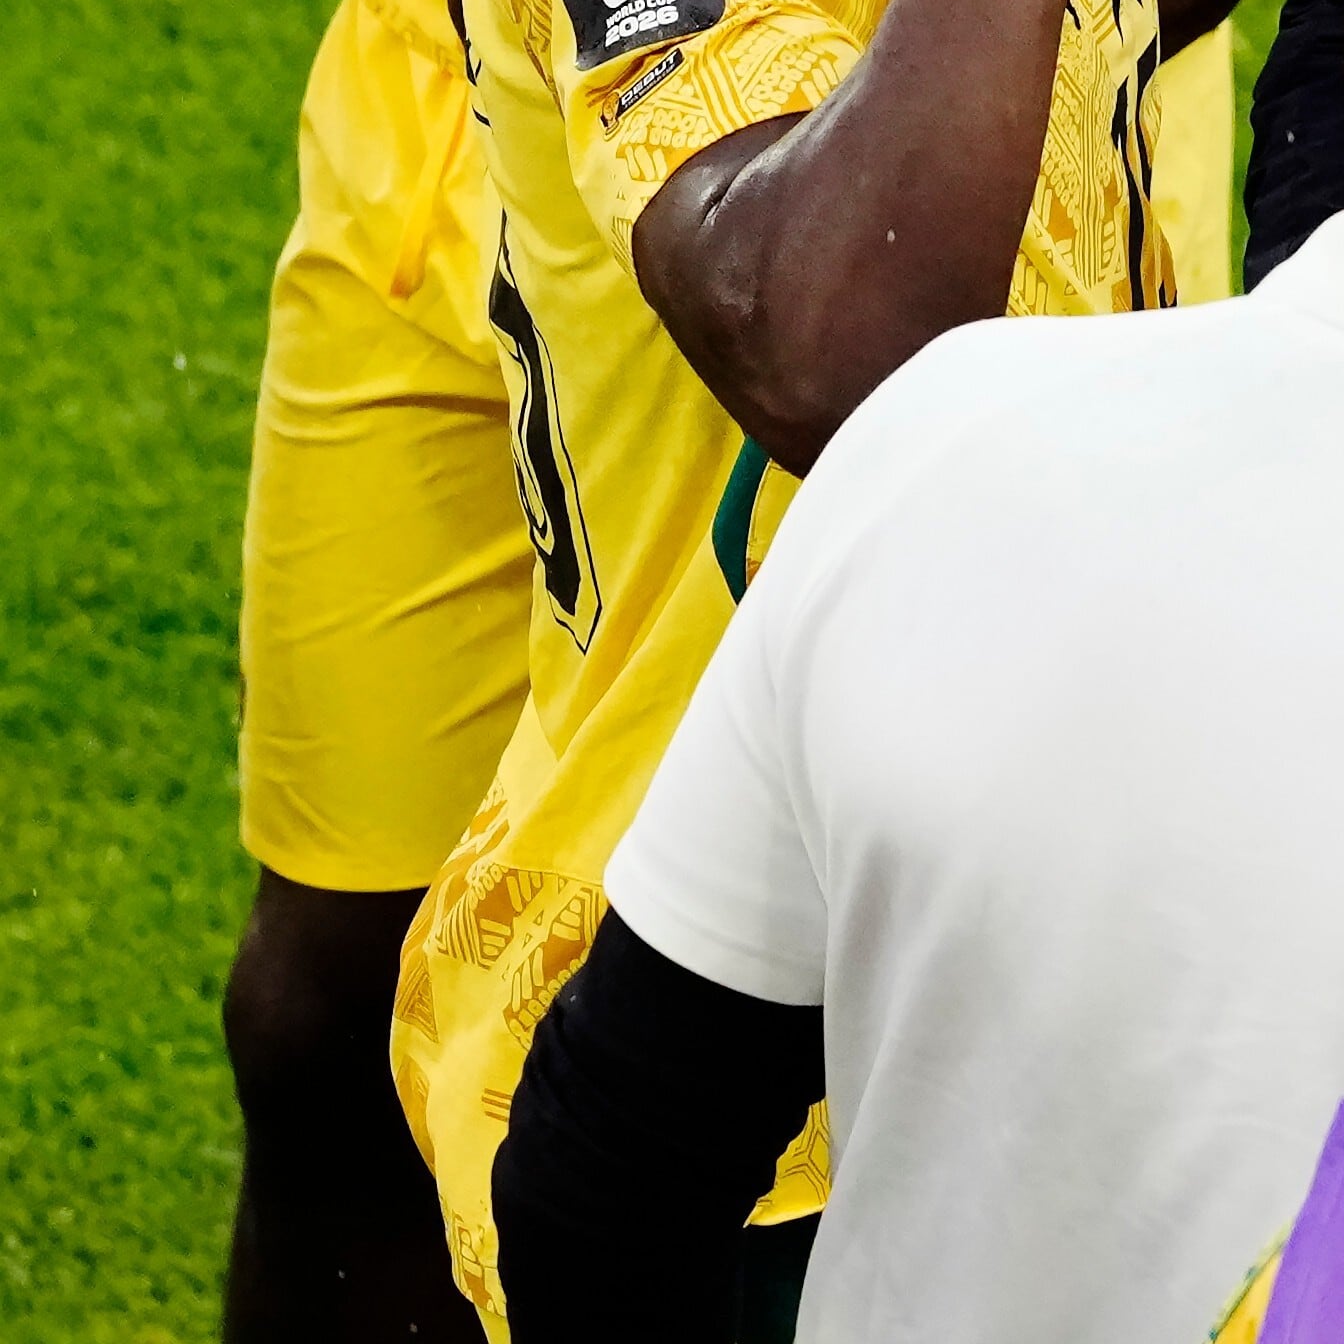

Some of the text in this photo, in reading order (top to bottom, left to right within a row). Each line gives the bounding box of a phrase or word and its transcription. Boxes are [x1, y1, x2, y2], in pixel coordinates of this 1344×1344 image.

[605, 5, 679, 47] 2026
[606, 0, 645, 29] WORLD
[621, 51, 677, 106] DEBUT
